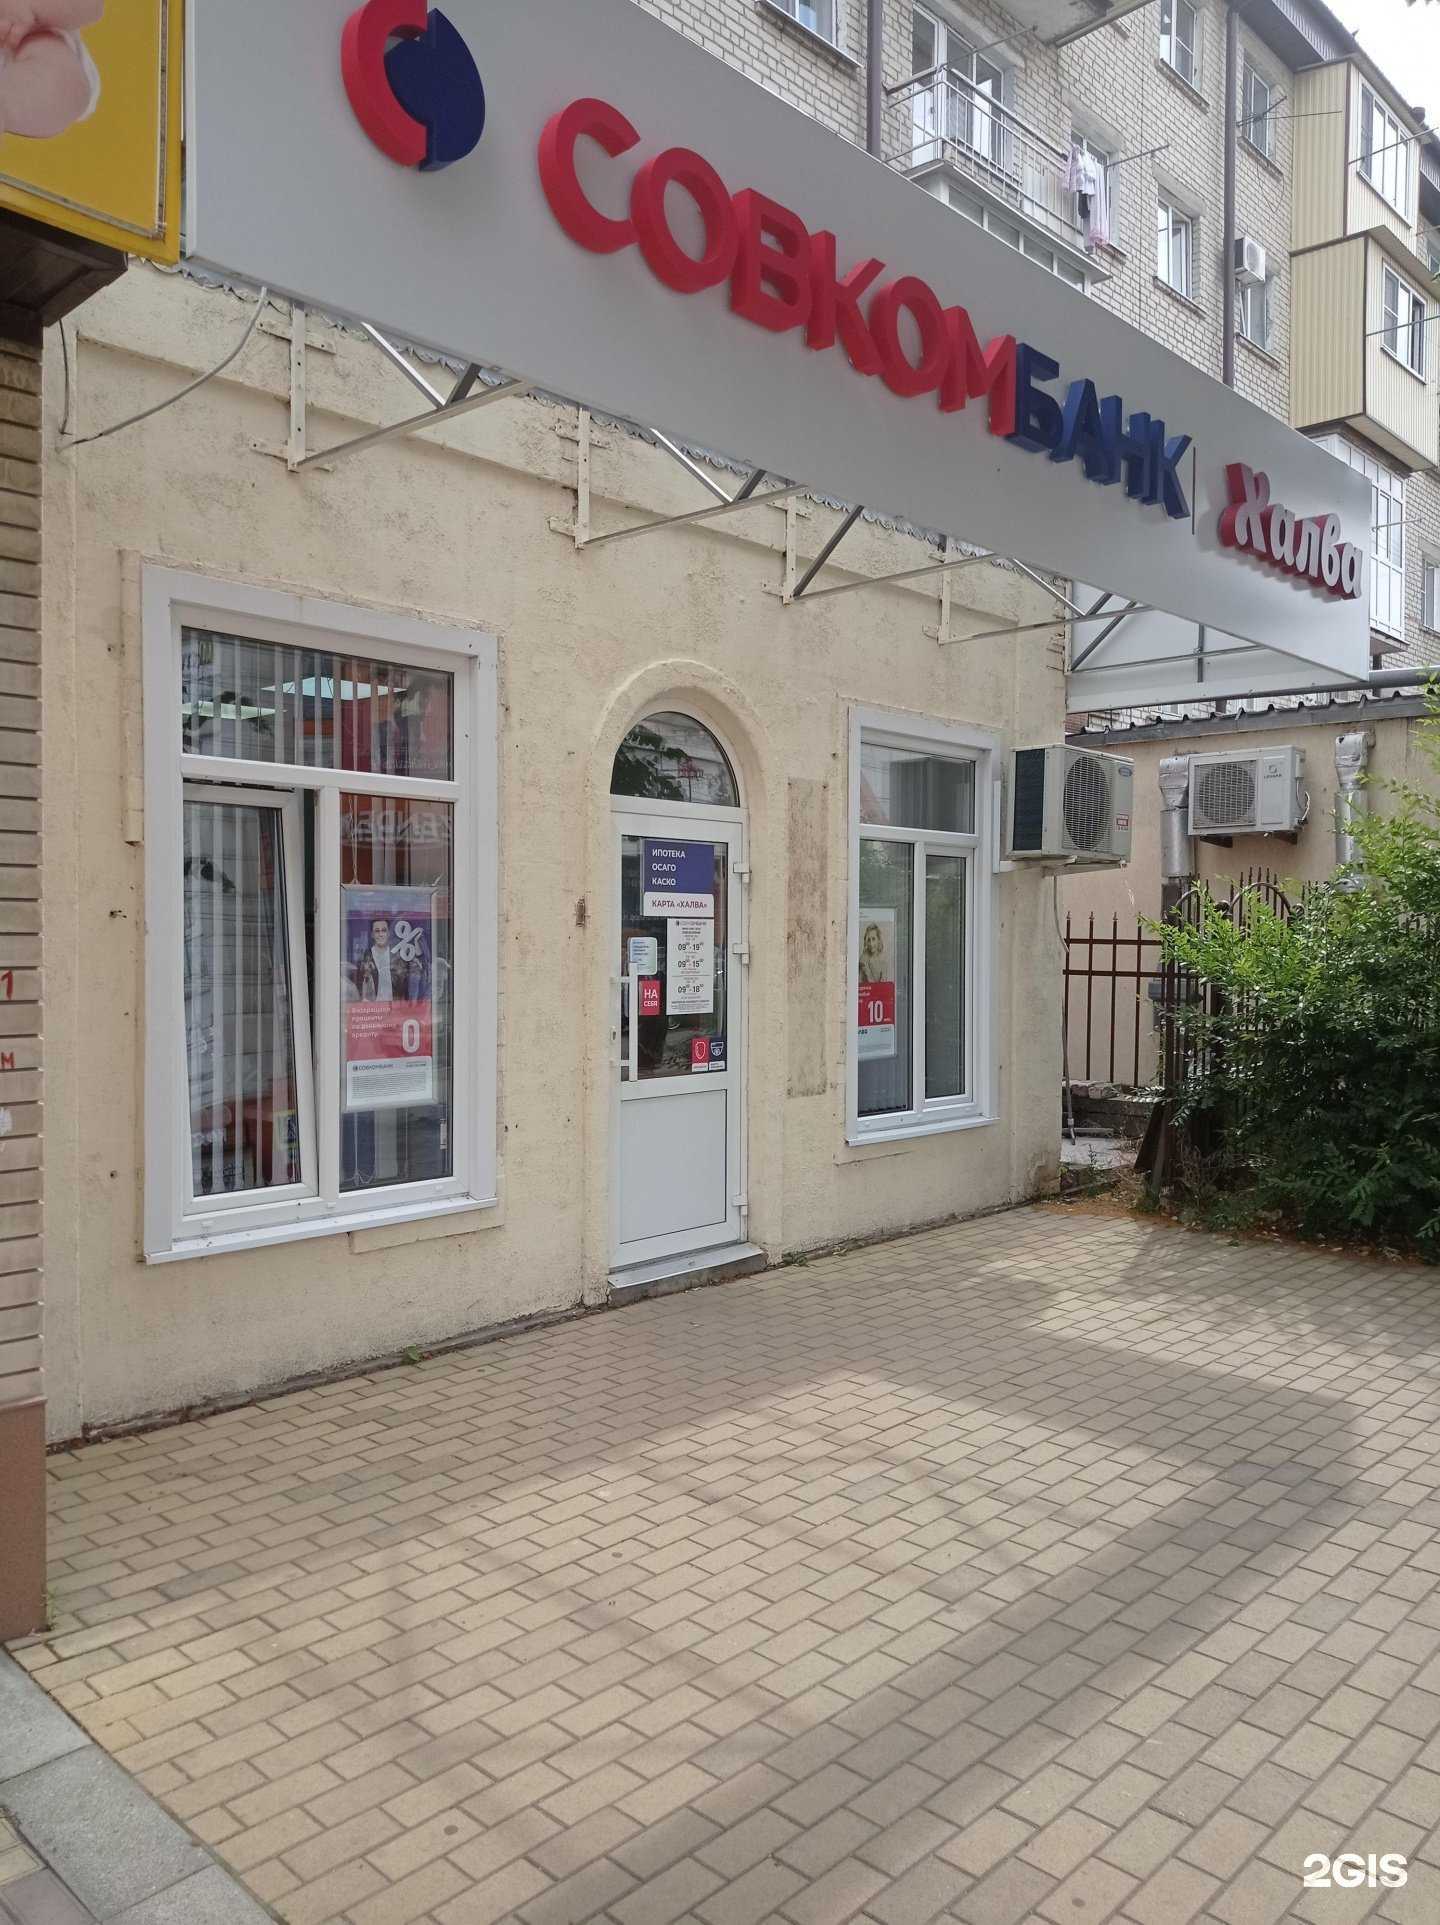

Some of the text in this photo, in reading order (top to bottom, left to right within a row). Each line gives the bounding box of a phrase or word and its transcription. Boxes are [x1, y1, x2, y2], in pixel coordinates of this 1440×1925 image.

[537, 97, 1192, 519] СОВКОМБАНК
[652, 848, 686, 858] ИПОТЕКА
[651, 863, 677, 872] ОСАГО
[651, 877, 677, 886] КАСКО
[652, 900, 708, 909] КАРТА «ХАЛВА»
[644, 989, 658, 999] НА
[868, 1000, 883, 1023] 10
[402, 1019, 420, 1053] 0
